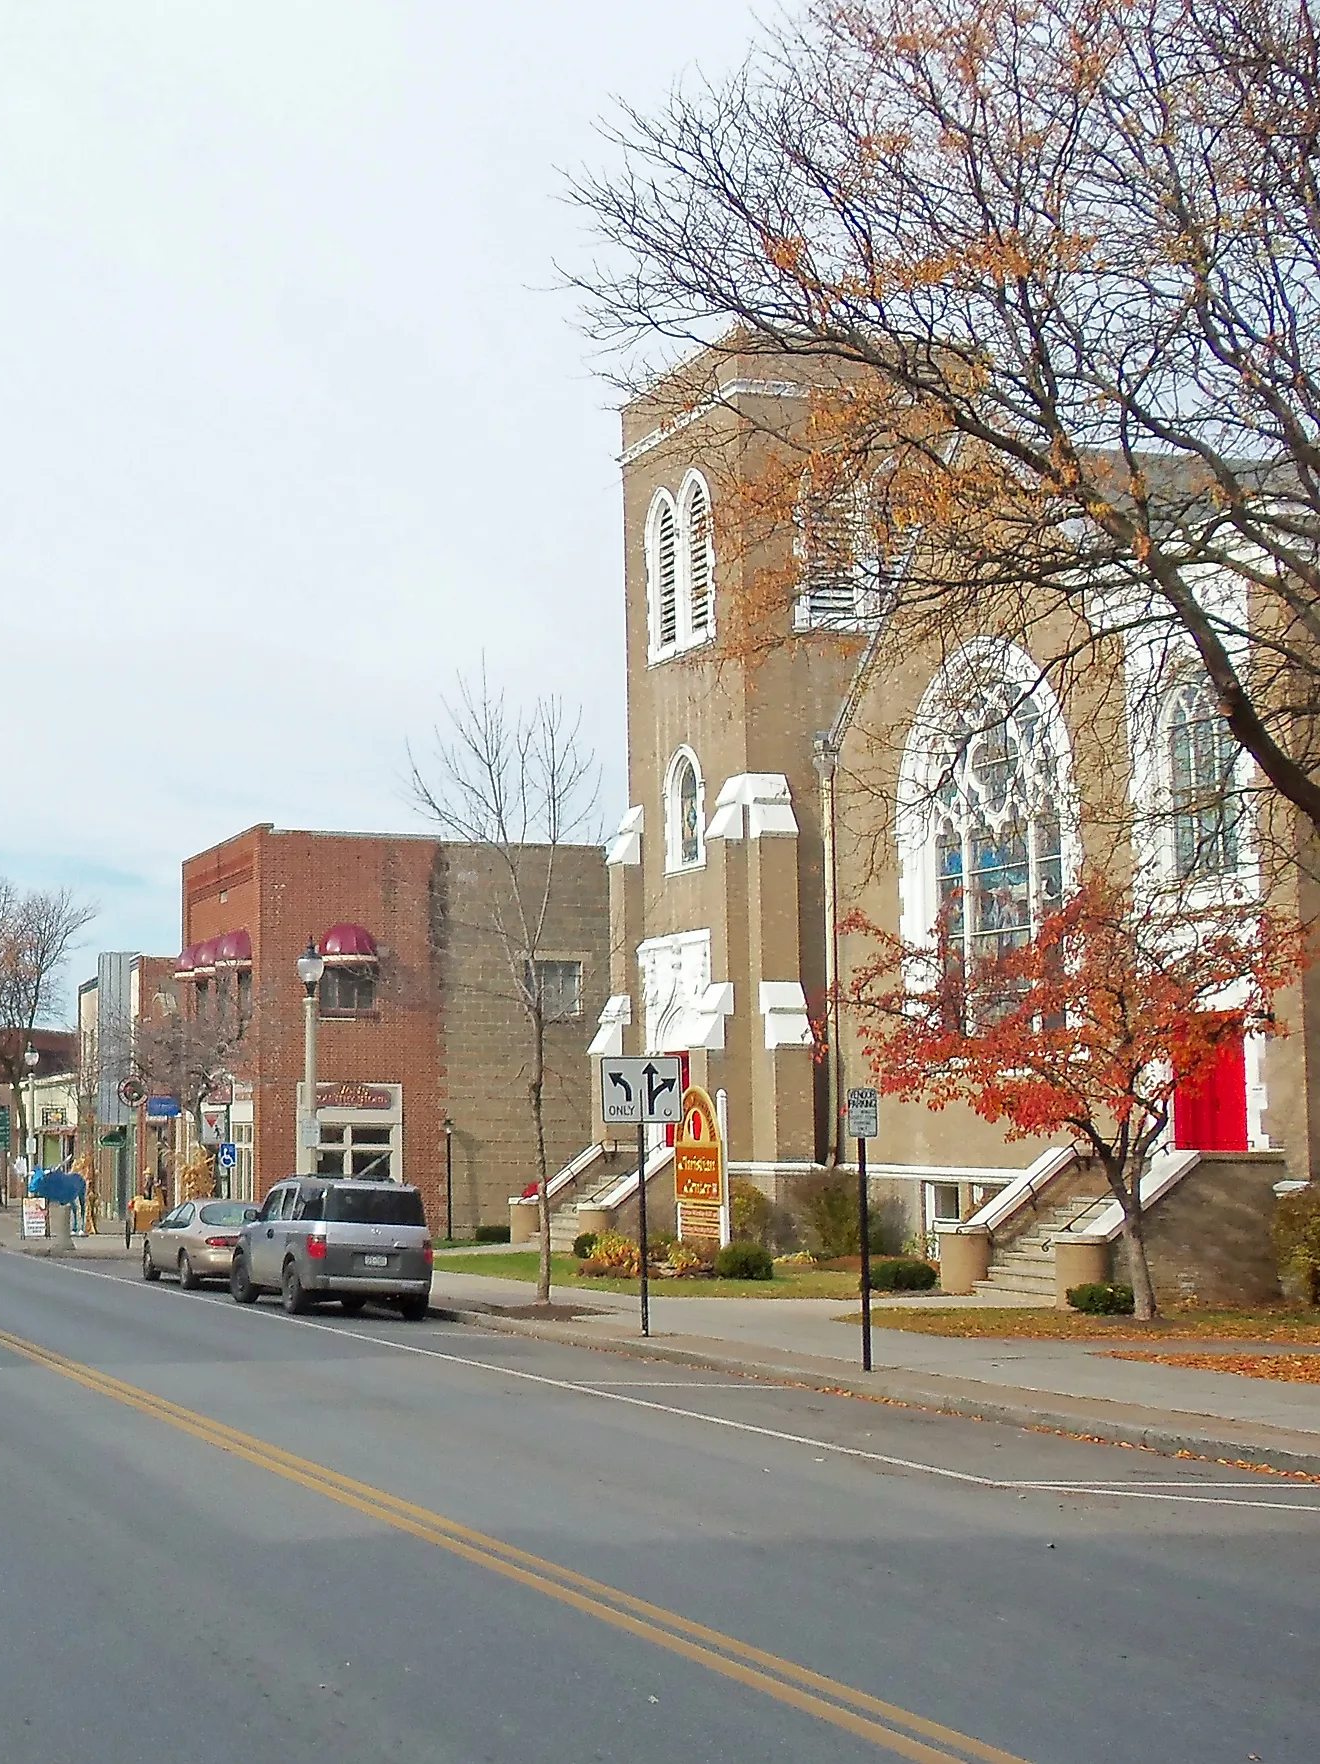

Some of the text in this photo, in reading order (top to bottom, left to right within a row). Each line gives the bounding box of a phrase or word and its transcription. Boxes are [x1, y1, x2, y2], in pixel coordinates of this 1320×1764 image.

[849, 1089, 877, 1099] VENDOR
[848, 1099, 877, 1109] PARKING
[608, 1105, 636, 1117] ONLY
[677, 1155, 716, 1173] Christian
[682, 1178, 712, 1196] Center
